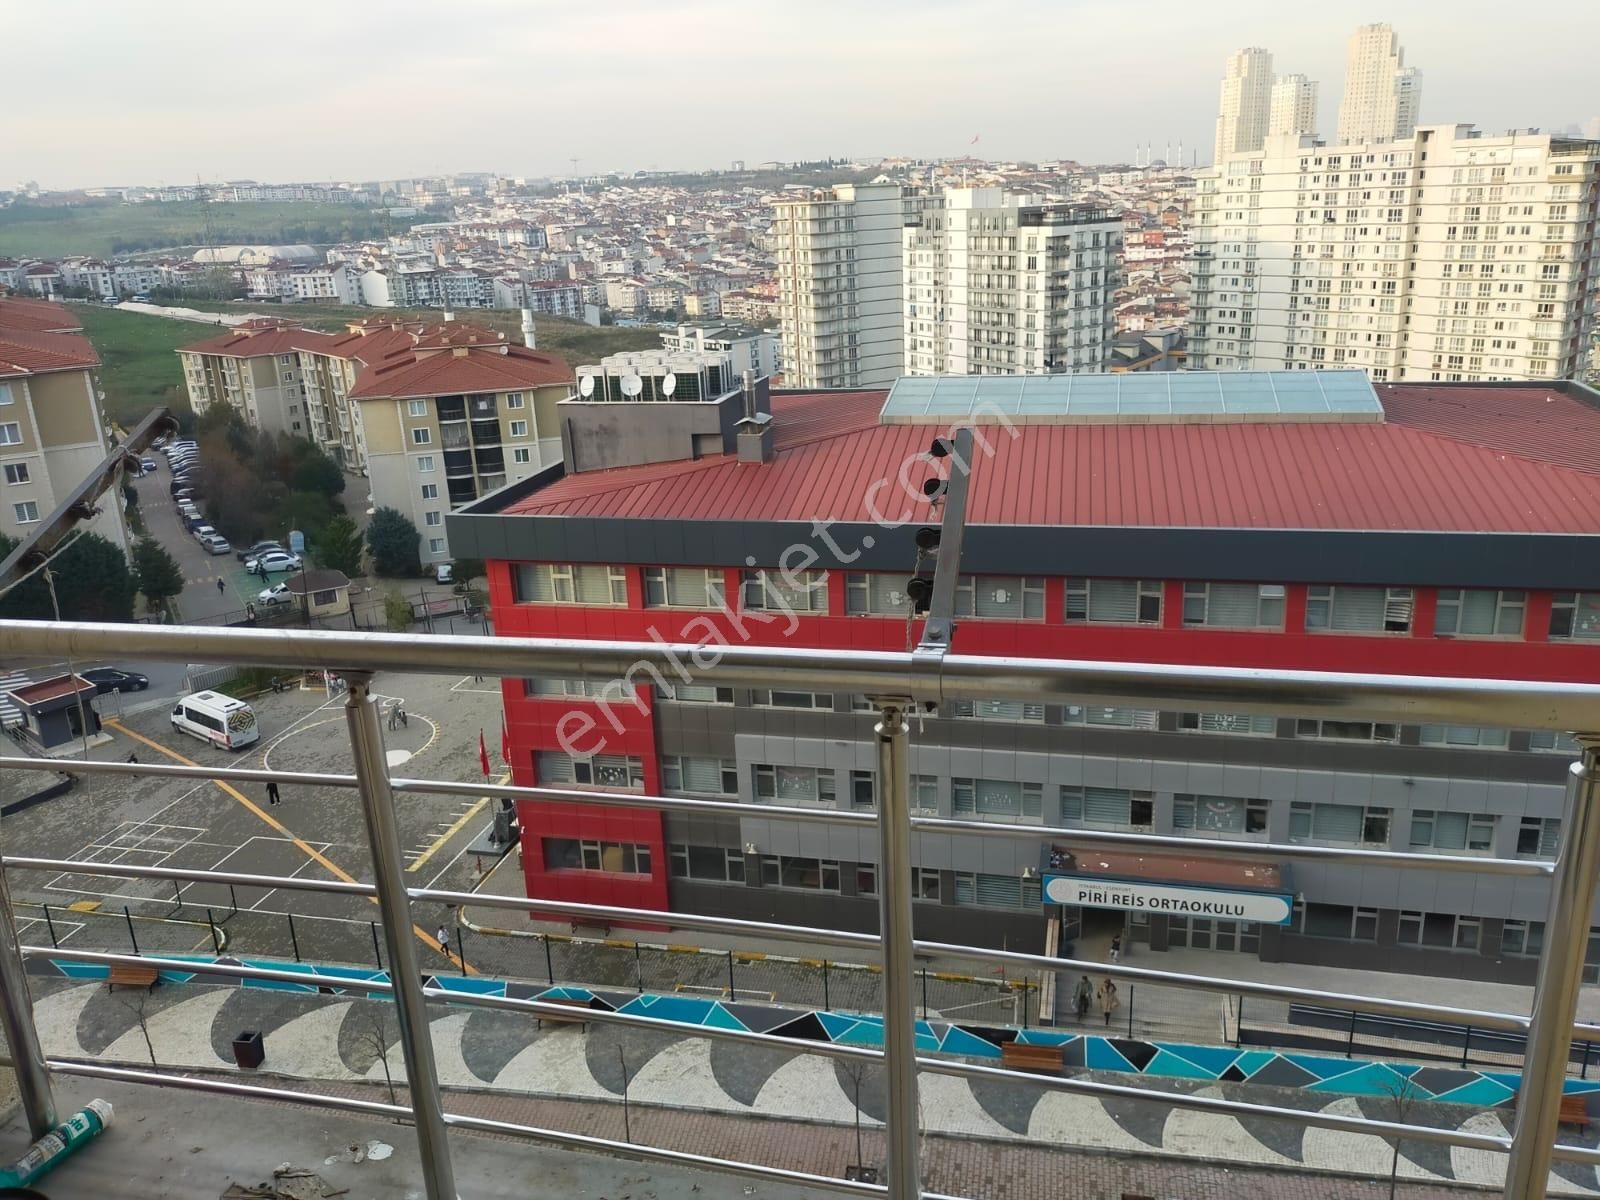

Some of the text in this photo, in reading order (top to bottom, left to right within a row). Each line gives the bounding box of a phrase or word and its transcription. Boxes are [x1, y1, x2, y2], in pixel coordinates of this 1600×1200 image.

[1078, 890, 1245, 916] PİRİ REİS ORTAOKULU
